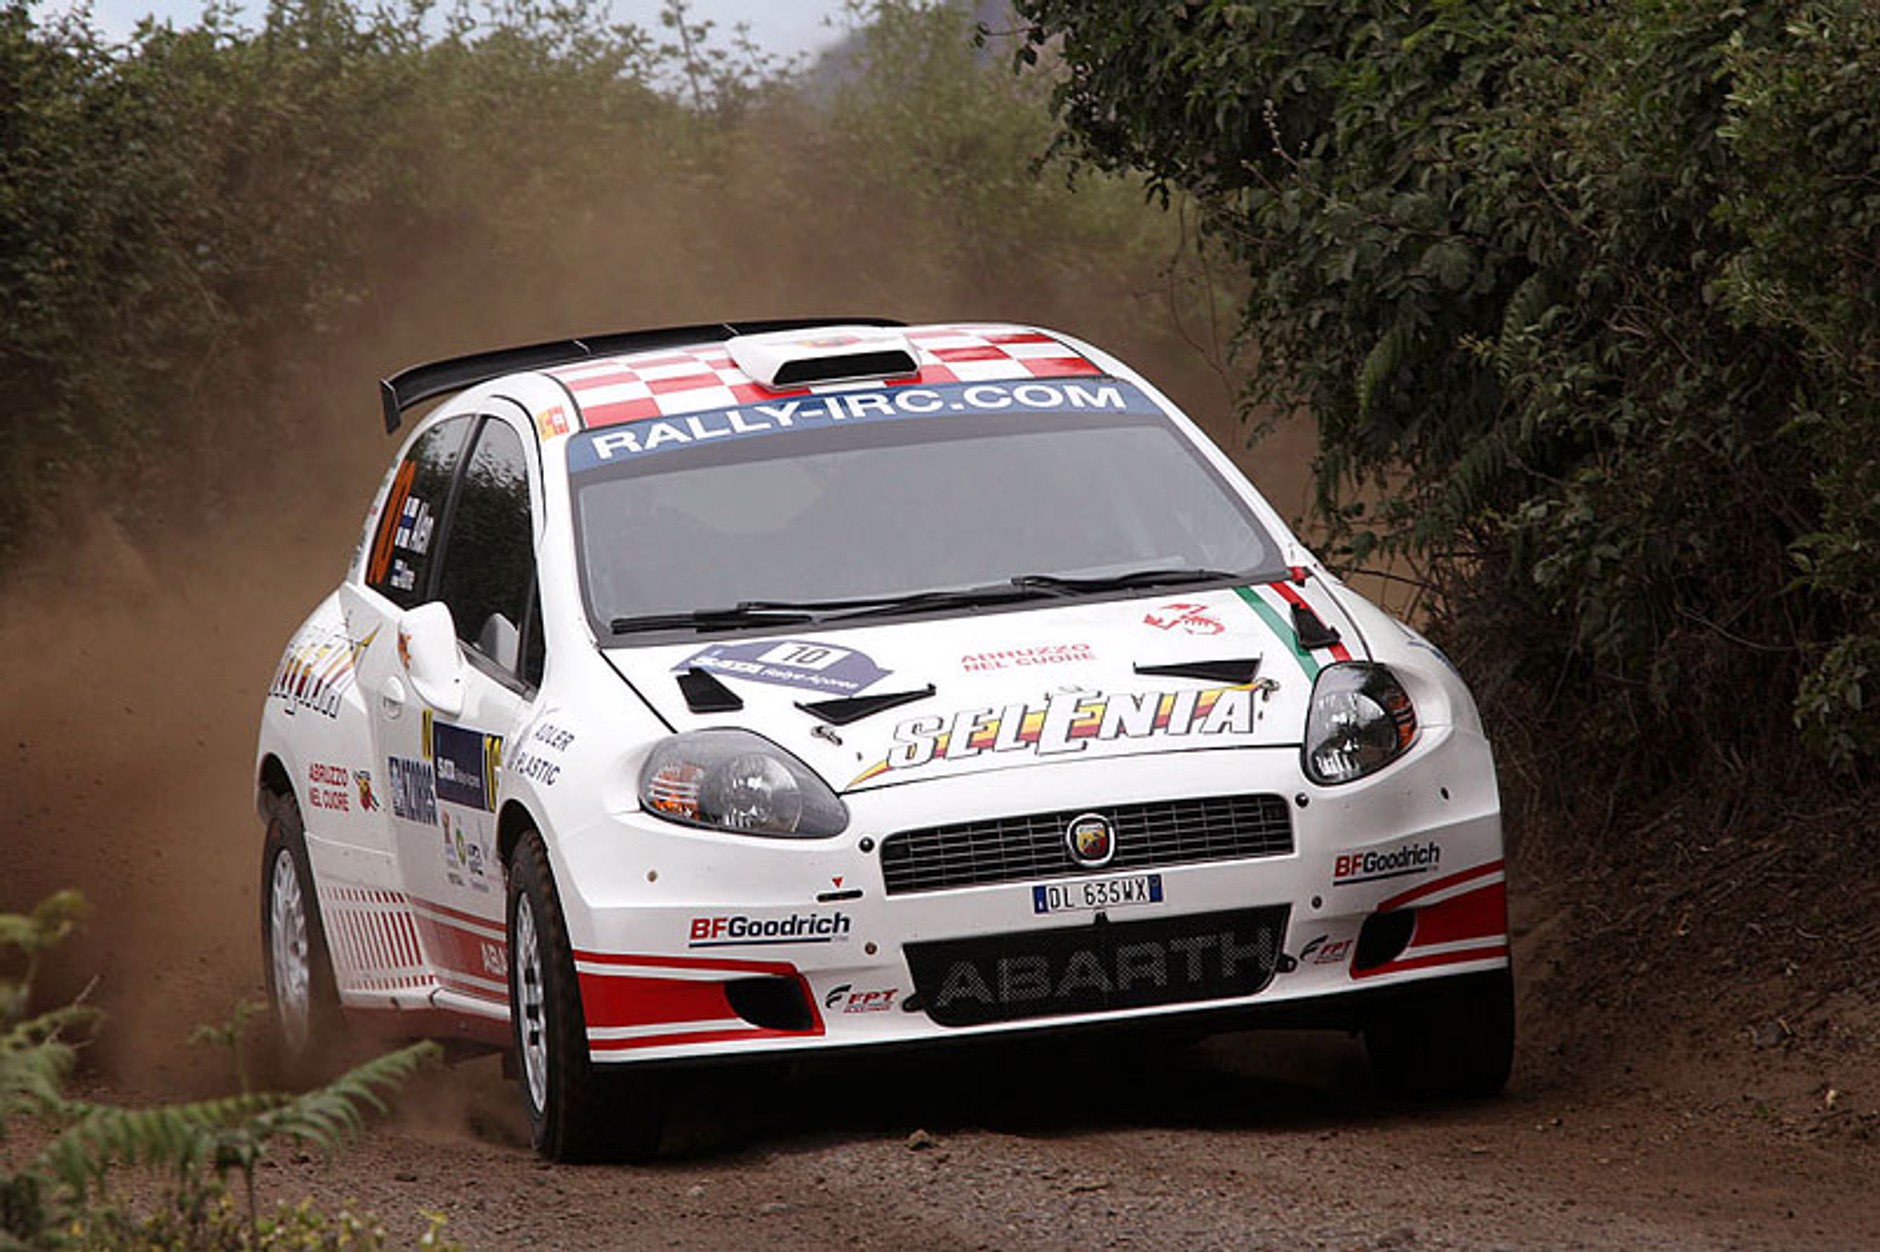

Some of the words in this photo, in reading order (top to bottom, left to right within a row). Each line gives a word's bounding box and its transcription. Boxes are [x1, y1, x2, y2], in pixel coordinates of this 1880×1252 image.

[592, 384, 1127, 460] RALLY-IRC.COM
[782, 645, 832, 664] 10
[961, 644, 1090, 663] ABRUZZO
[964, 661, 1008, 672] NEL
[1015, 653, 1096, 667] CUORE
[1335, 842, 1440, 878] BFGoodrich
[1049, 886, 1075, 908] DL
[1084, 878, 1146, 905] 635WX
[690, 911, 850, 940] BFGoodrich
[937, 926, 1277, 1009] ABARTH
